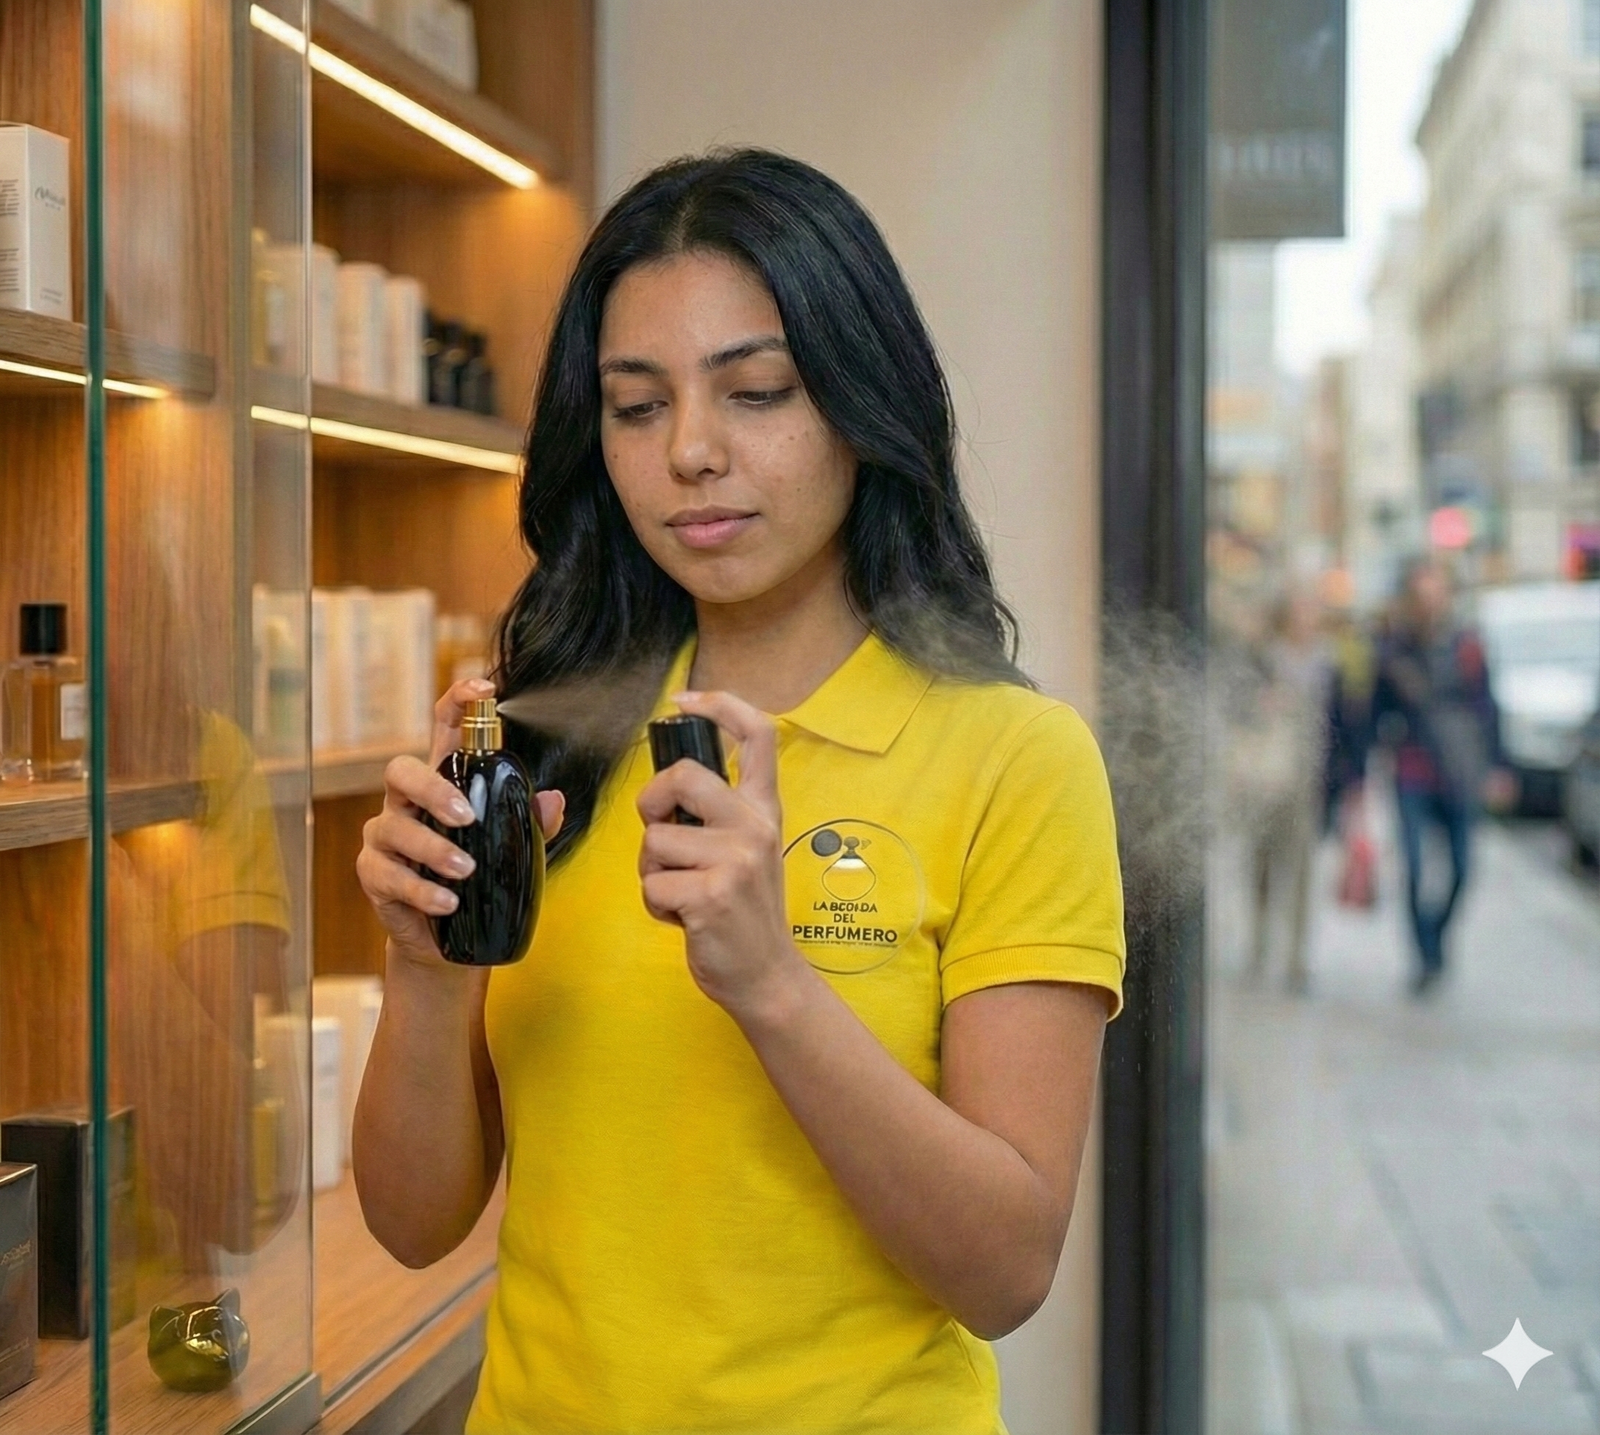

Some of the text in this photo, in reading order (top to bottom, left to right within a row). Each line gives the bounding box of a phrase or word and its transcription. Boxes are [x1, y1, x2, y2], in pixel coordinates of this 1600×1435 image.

[813, 901, 828, 911] LA
[833, 913, 856, 923] DEL
[792, 925, 898, 943] PERFUMERO
